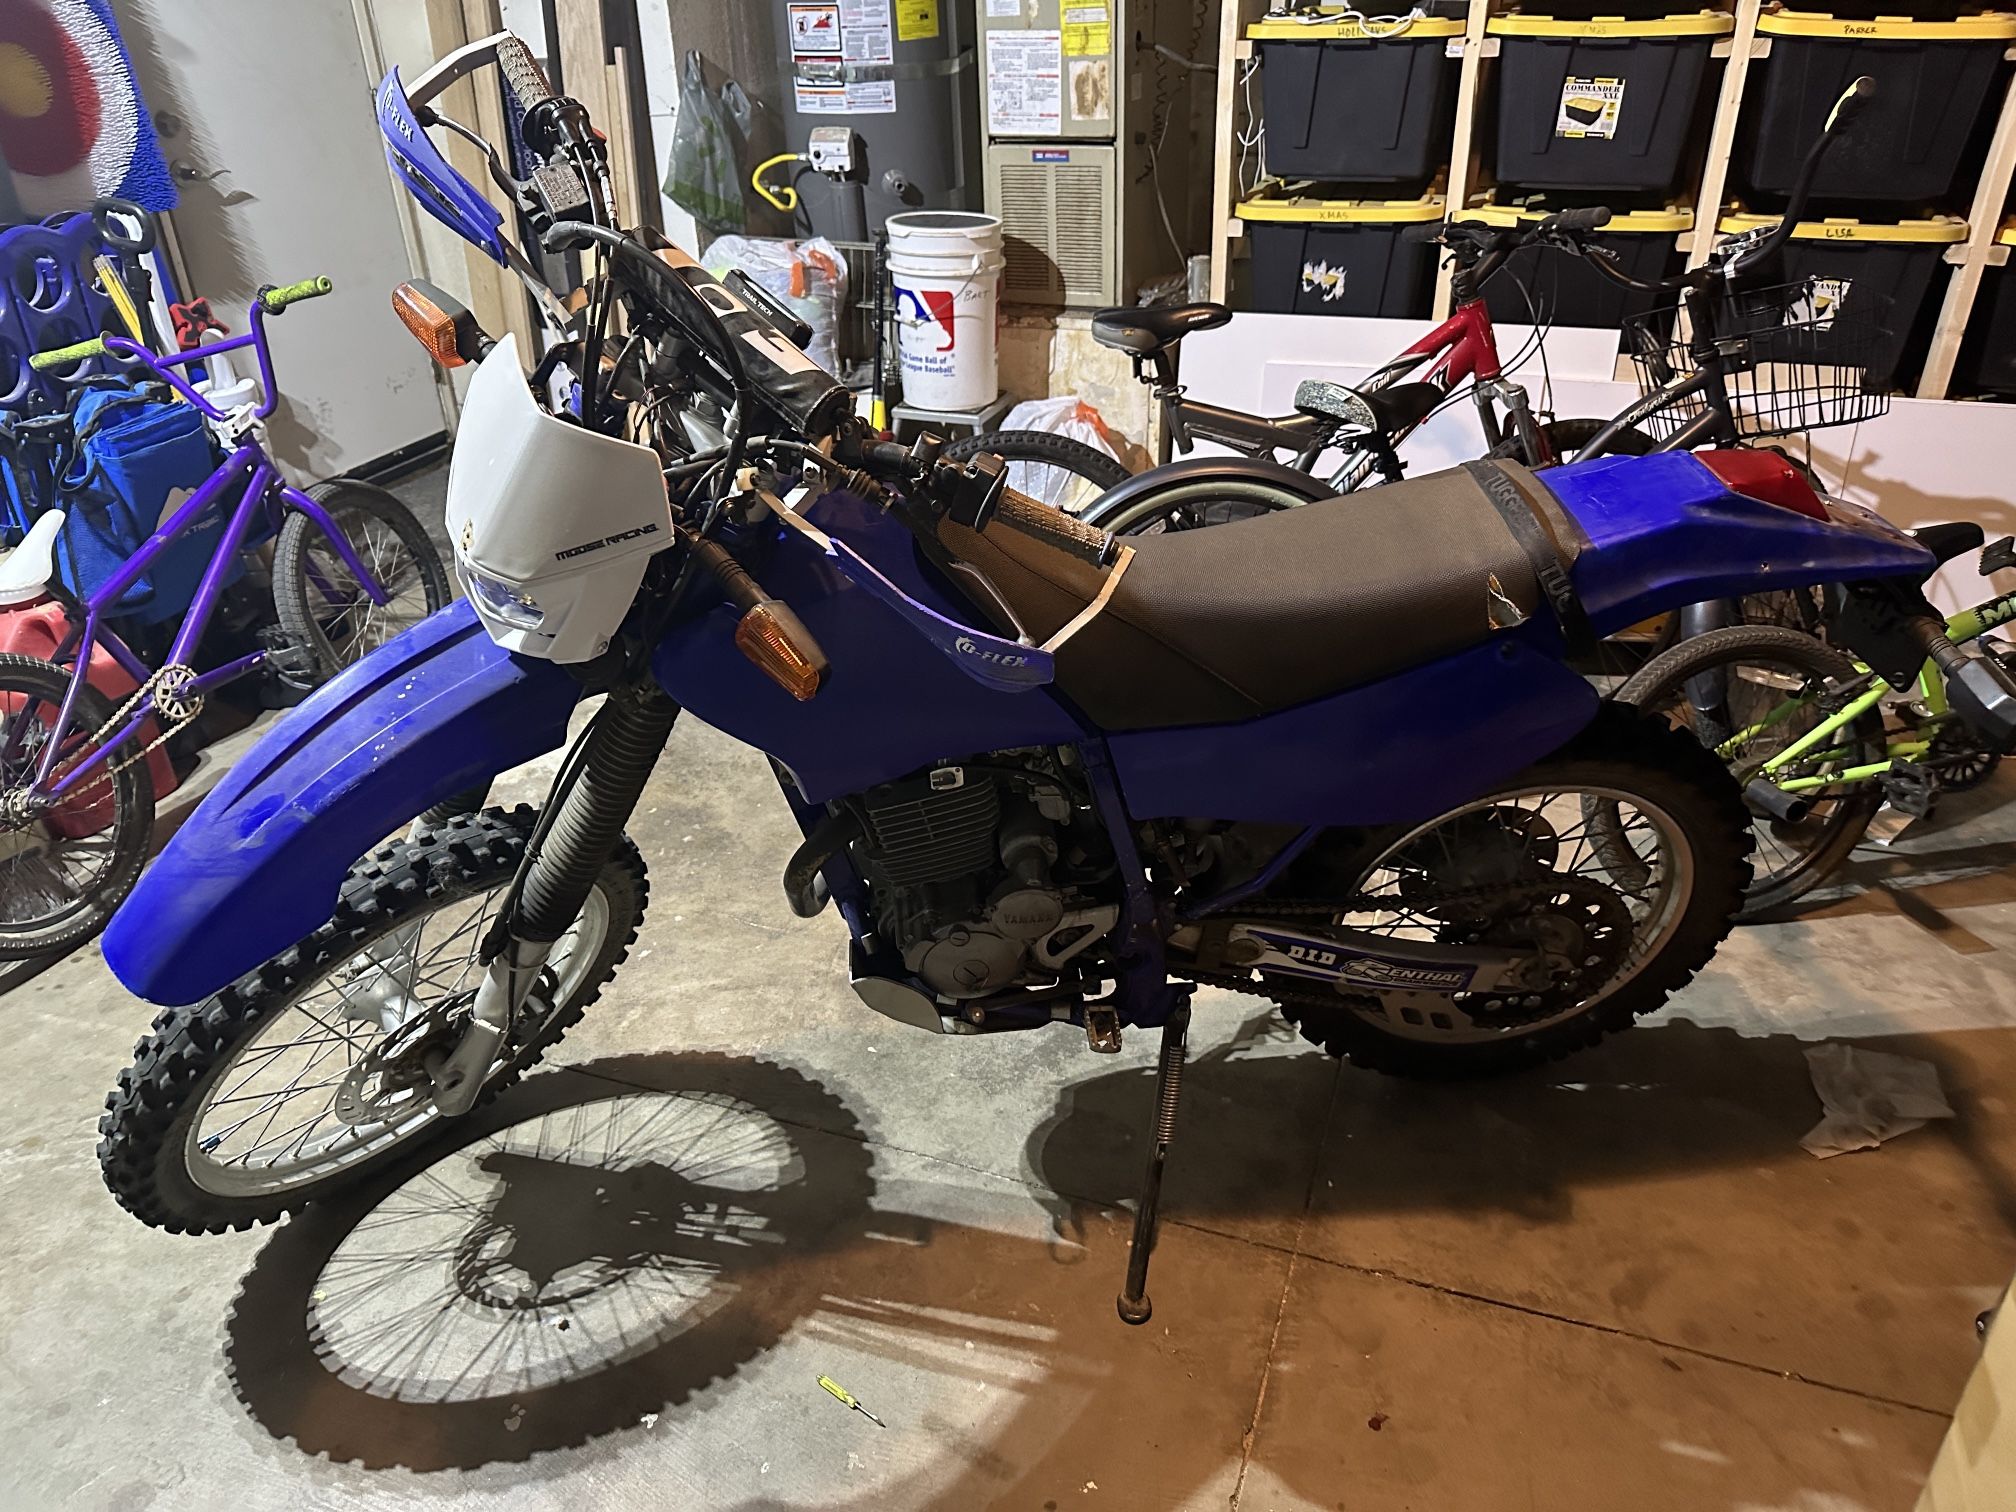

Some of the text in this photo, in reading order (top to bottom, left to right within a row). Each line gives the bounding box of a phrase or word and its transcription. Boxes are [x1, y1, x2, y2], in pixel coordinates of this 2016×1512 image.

[1337, 24, 1387, 37] HOLIAYS
[1565, 84, 1621, 93] COMMANDER
[1602, 92, 1620, 100] XXL
[1319, 210, 1349, 220] XMAS
[742, 287, 774, 317] TRAIL TECH
[925, 365, 952, 374] Baseball
[555, 523, 660, 561] MOOSE RACING
